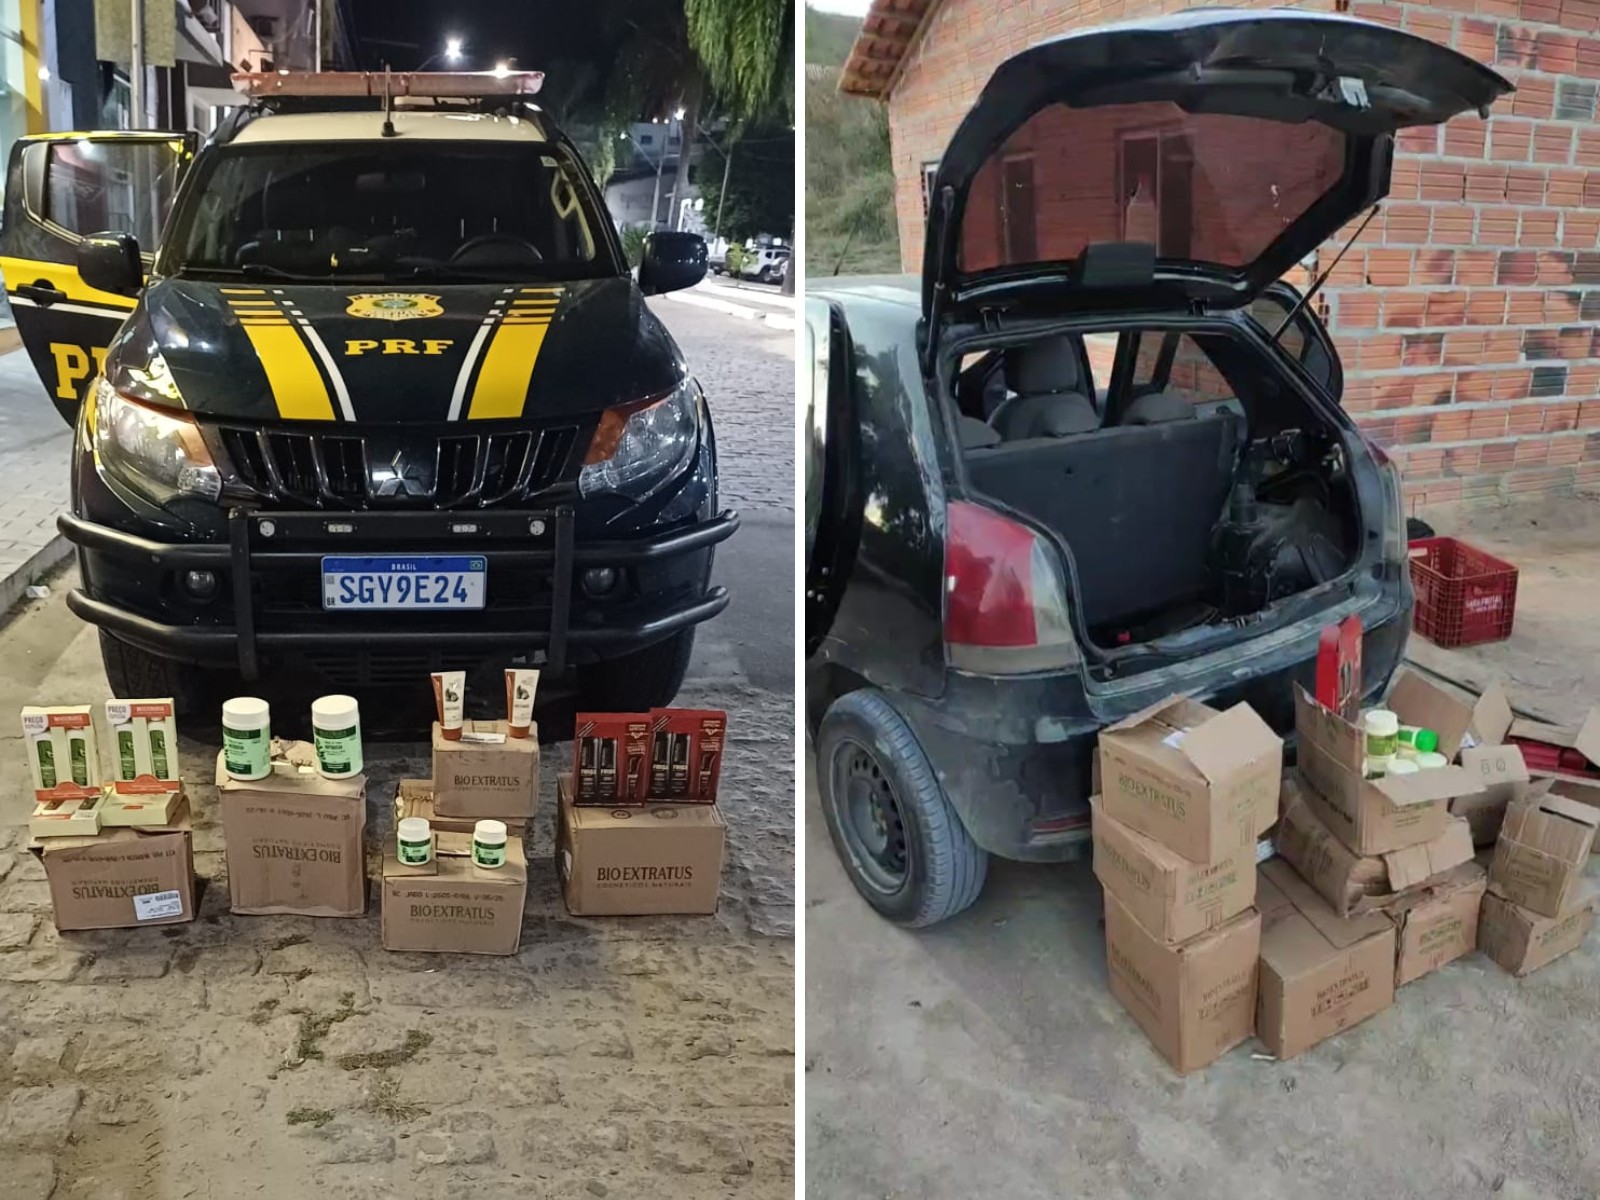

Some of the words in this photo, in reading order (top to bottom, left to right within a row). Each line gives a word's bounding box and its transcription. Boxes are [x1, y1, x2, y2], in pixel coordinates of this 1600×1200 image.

[345, 339, 454, 356] PRF
[49, 342, 109, 400] P
[391, 563, 417, 571] BRASIL
[339, 574, 468, 604] SGY9E24
[622, 866, 693, 881] EXTRATUS
